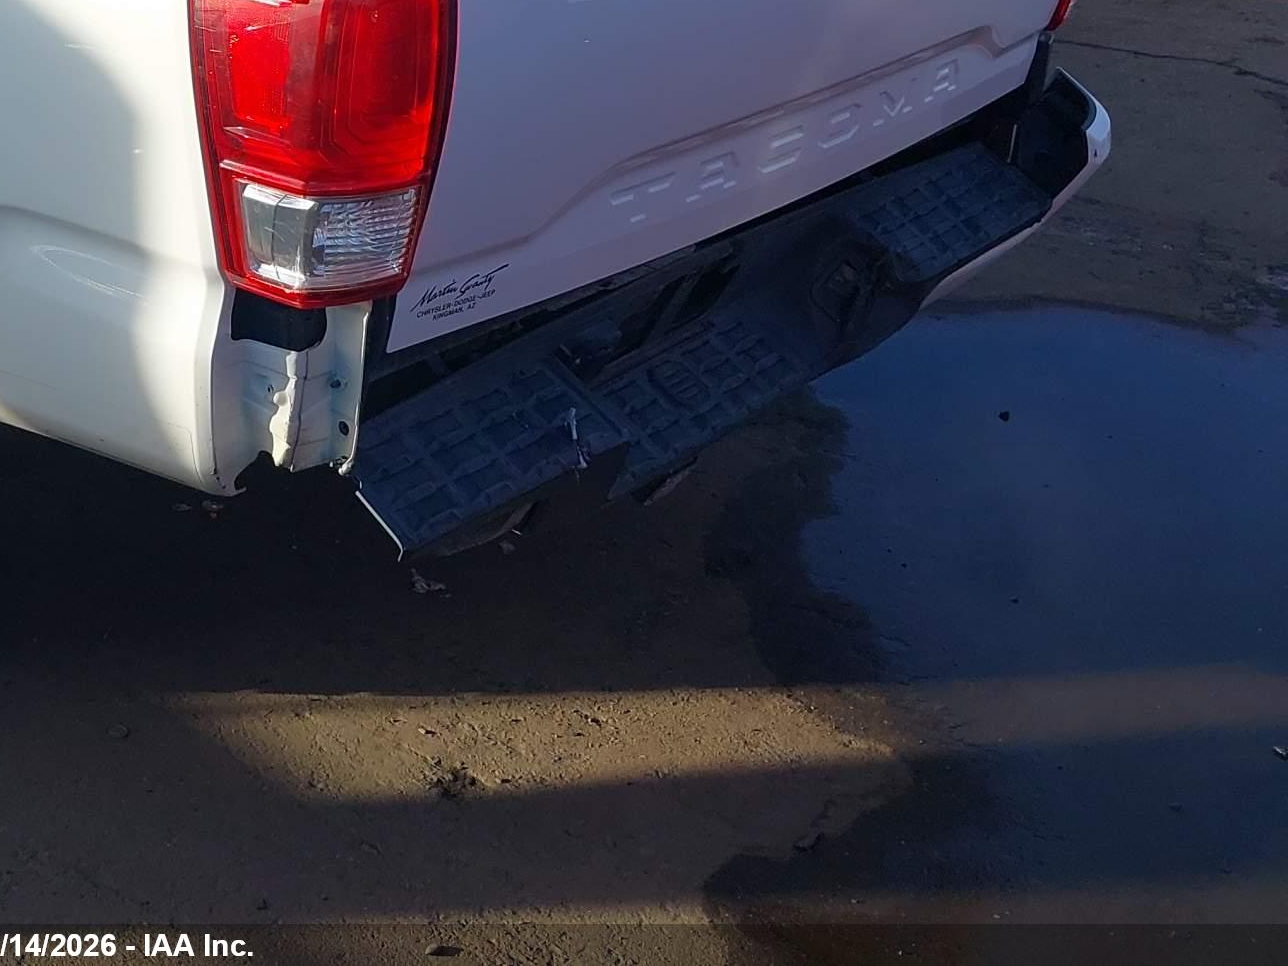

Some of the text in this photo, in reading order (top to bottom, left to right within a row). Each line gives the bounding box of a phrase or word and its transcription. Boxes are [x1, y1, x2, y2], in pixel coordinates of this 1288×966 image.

[610, 58, 960, 224] TACOMA
[410, 278, 459, 312] Martin
[466, 302, 477, 310] AZ
